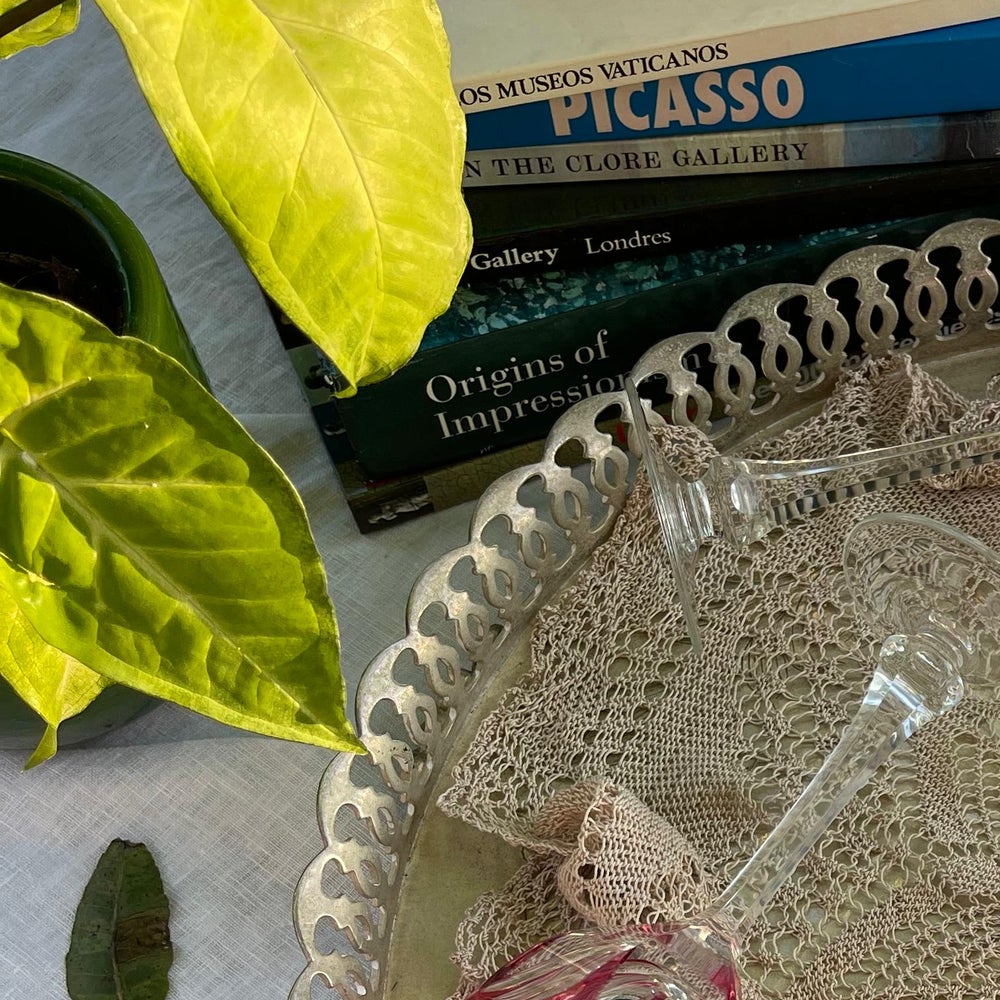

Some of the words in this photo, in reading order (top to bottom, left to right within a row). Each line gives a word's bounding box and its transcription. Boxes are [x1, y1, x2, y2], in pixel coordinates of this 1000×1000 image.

[459, 86, 491, 106] OS
[496, 68, 593, 99] MUSEOS
[597, 43, 728, 80] VATICANOS
[549, 65, 804, 137] PICASSO
[464, 160, 481, 178] N
[492, 157, 555, 177] THE
[566, 150, 662, 174] CLORE
[673, 143, 809, 167] GALLERY
[471, 245, 559, 270] Gallery
[585, 229, 672, 255] Londres
[426, 357, 564, 403] Origins
[575, 329, 610, 366] of
